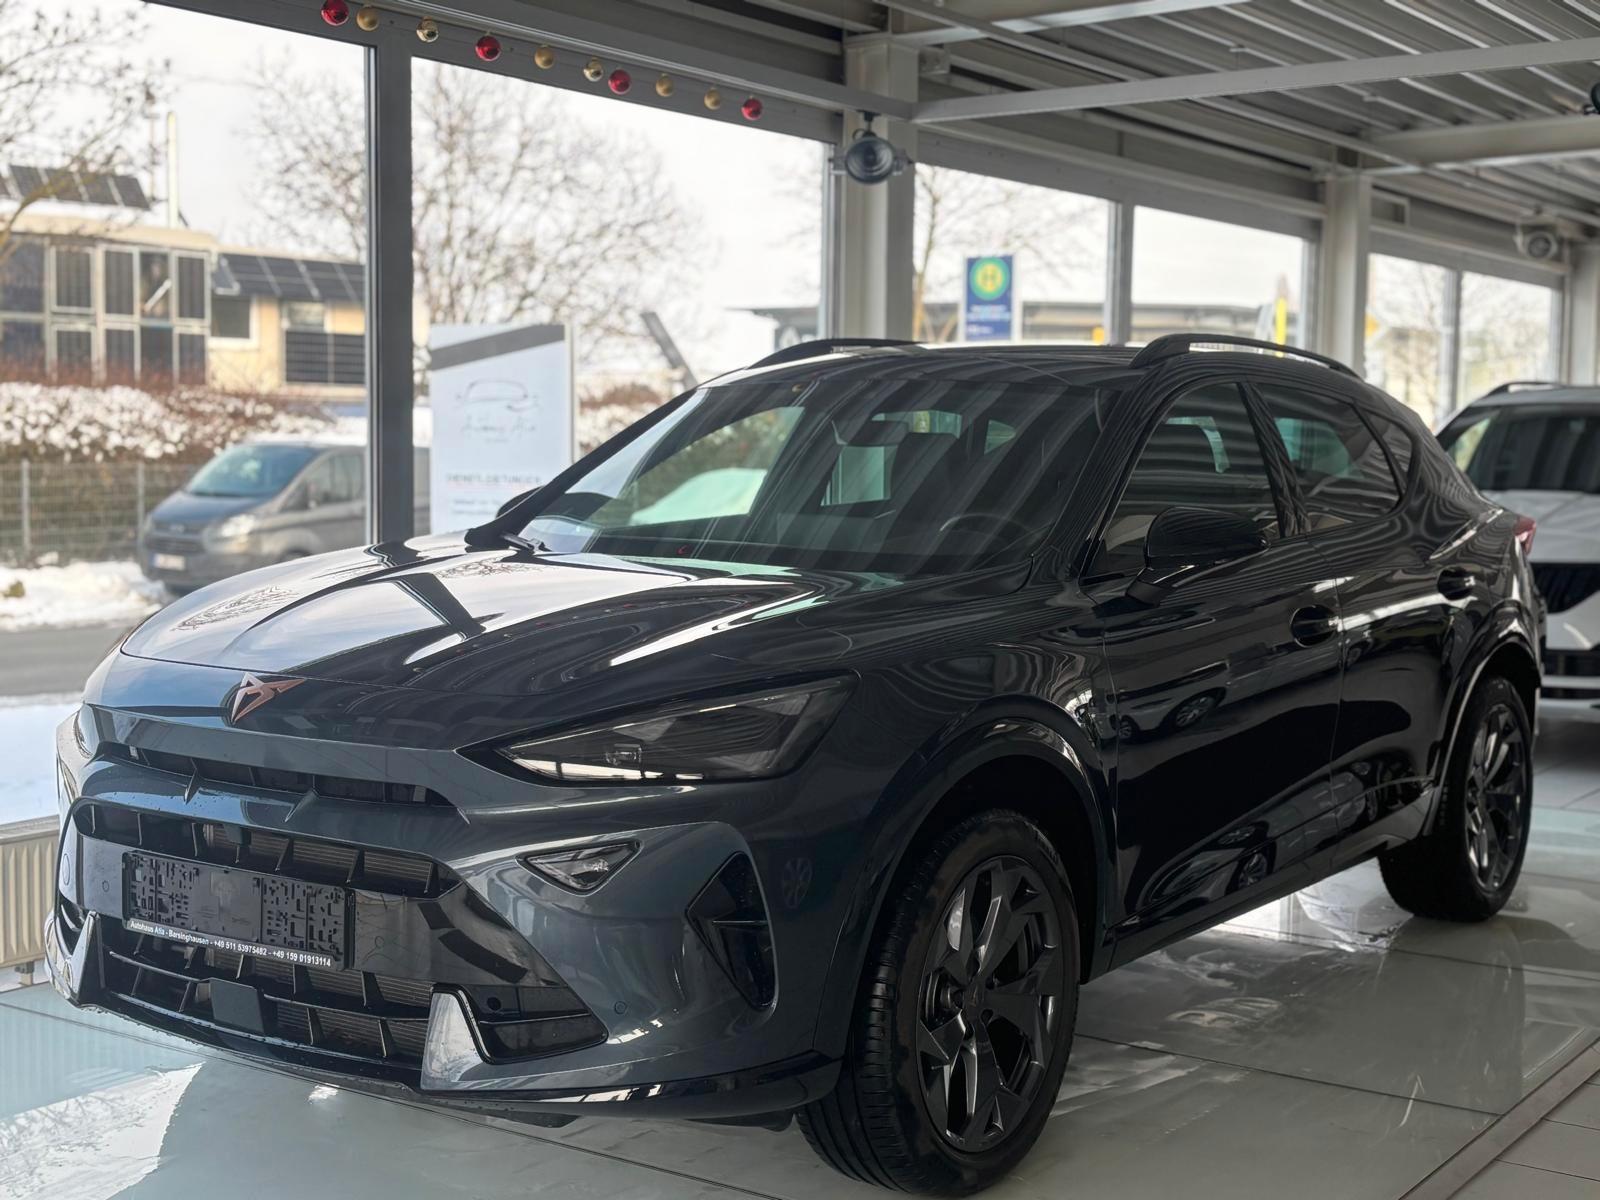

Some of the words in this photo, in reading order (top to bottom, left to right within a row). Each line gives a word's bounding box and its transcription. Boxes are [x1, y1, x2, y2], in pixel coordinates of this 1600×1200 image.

[130, 920, 154, 933] Autohaus
[214, 940, 225, 948] +49
[225, 941, 236, 951] 511
[272, 949, 285, 959] +49
[286, 951, 298, 962] 159
[299, 953, 331, 967] 01913114
